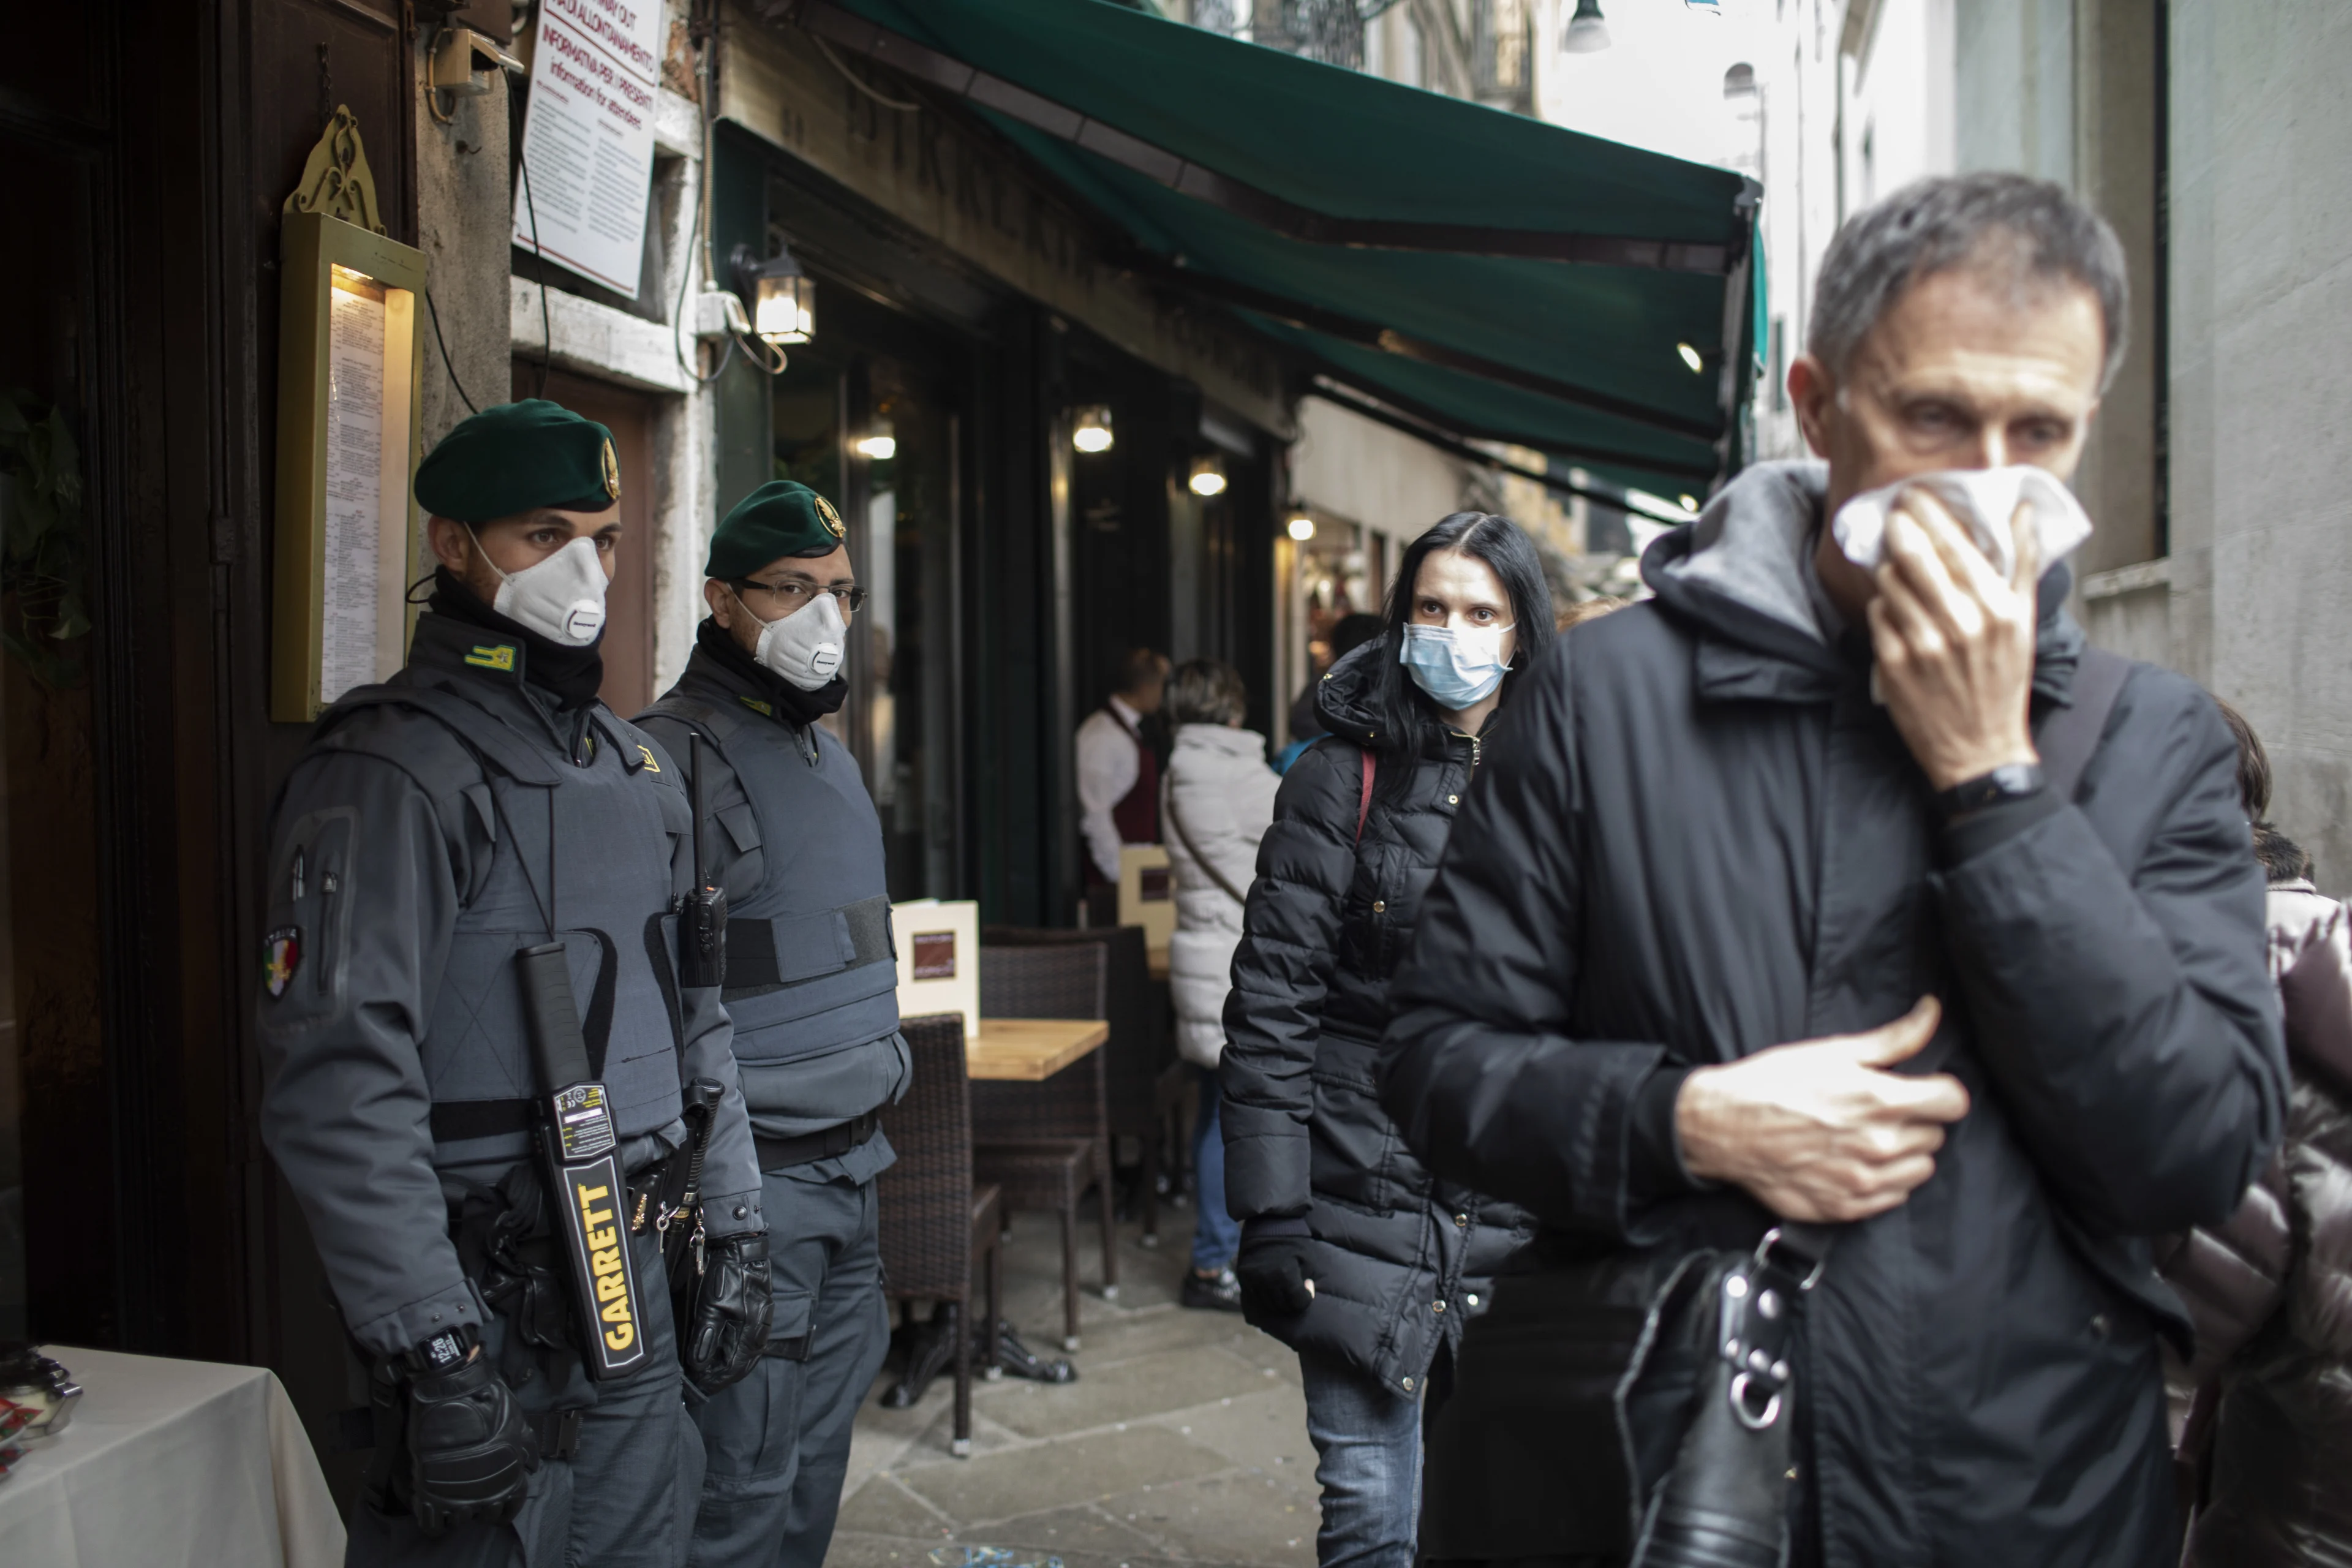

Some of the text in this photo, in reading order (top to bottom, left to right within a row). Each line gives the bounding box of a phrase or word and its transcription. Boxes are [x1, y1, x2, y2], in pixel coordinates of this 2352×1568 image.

[577, 2, 655, 72] ALLONTANAMENTO
[619, 4, 638, 31] OUT
[543, 23, 598, 74] INFORMATIVA
[598, 62, 613, 85] PER
[619, 75, 654, 113] PRESENTI
[551, 56, 595, 98] information
[597, 87, 606, 106] for
[606, 99, 642, 130] attendees
[263, 928, 296, 947] ITALIA
[578, 1185, 635, 1351] GARRETT
[432, 1338, 451, 1363] 12:26
